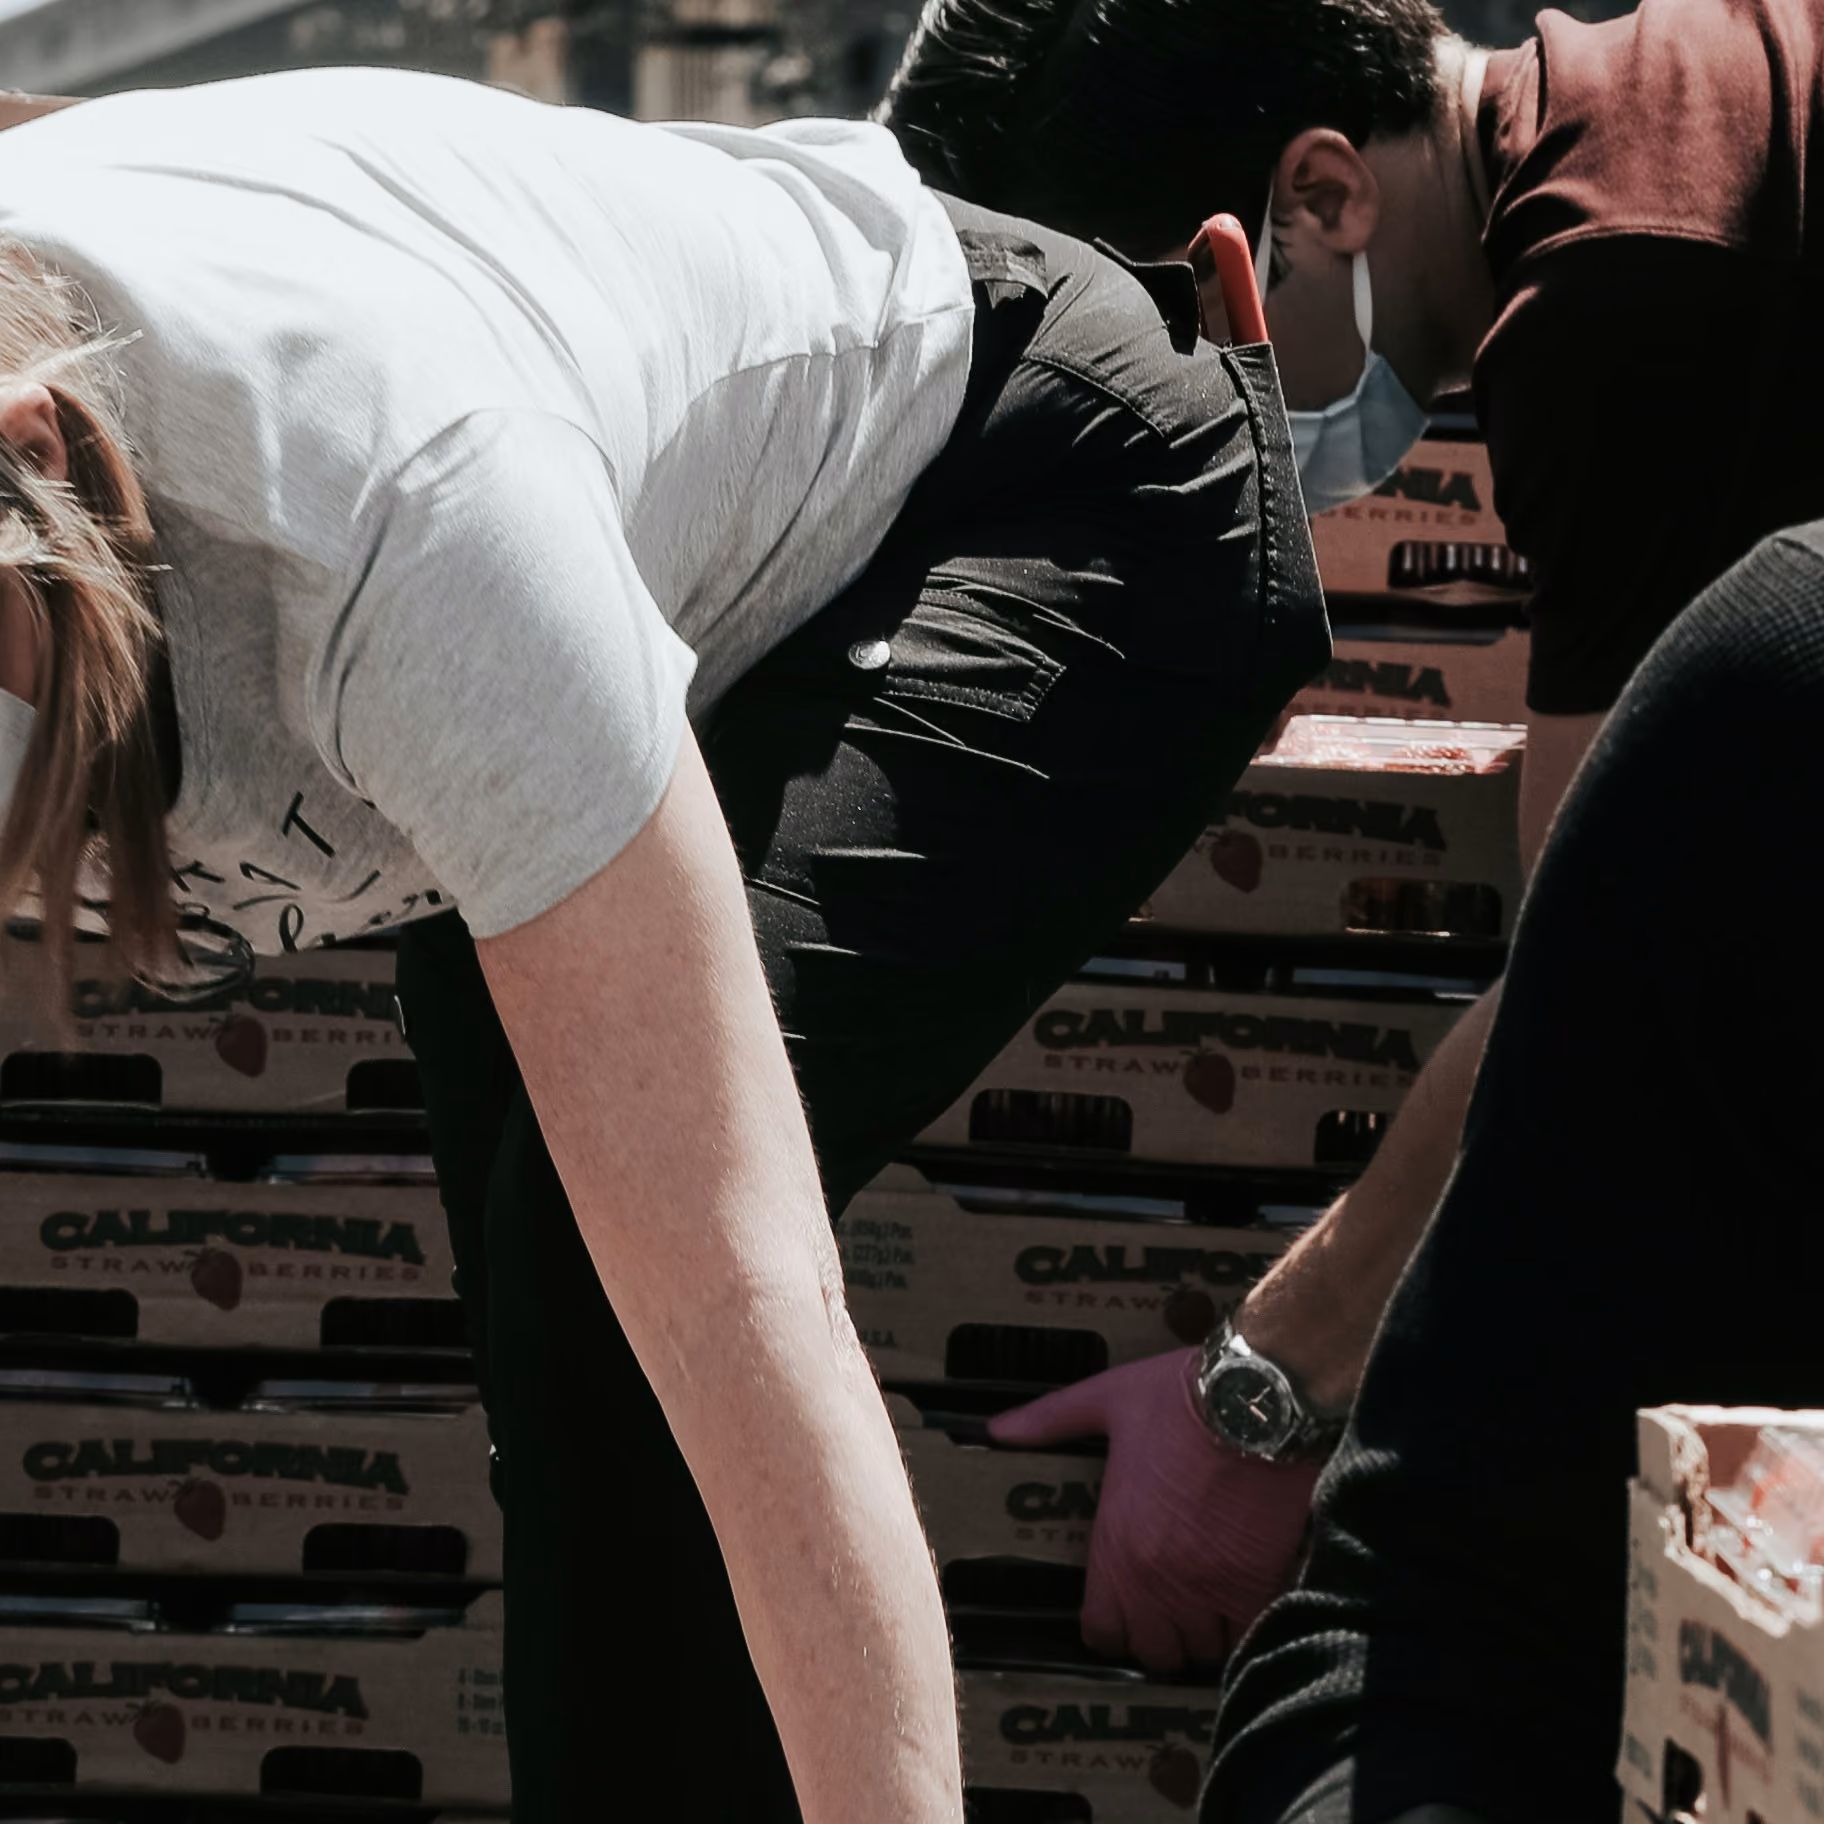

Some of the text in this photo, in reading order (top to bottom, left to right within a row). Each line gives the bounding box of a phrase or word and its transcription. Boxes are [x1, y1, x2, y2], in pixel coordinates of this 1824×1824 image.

[1033, 1007, 1425, 1072] CALIFORNIA
[40, 1209, 426, 1266] CALIFORNIA
[22, 1438, 409, 1496] CALIFORNIA
